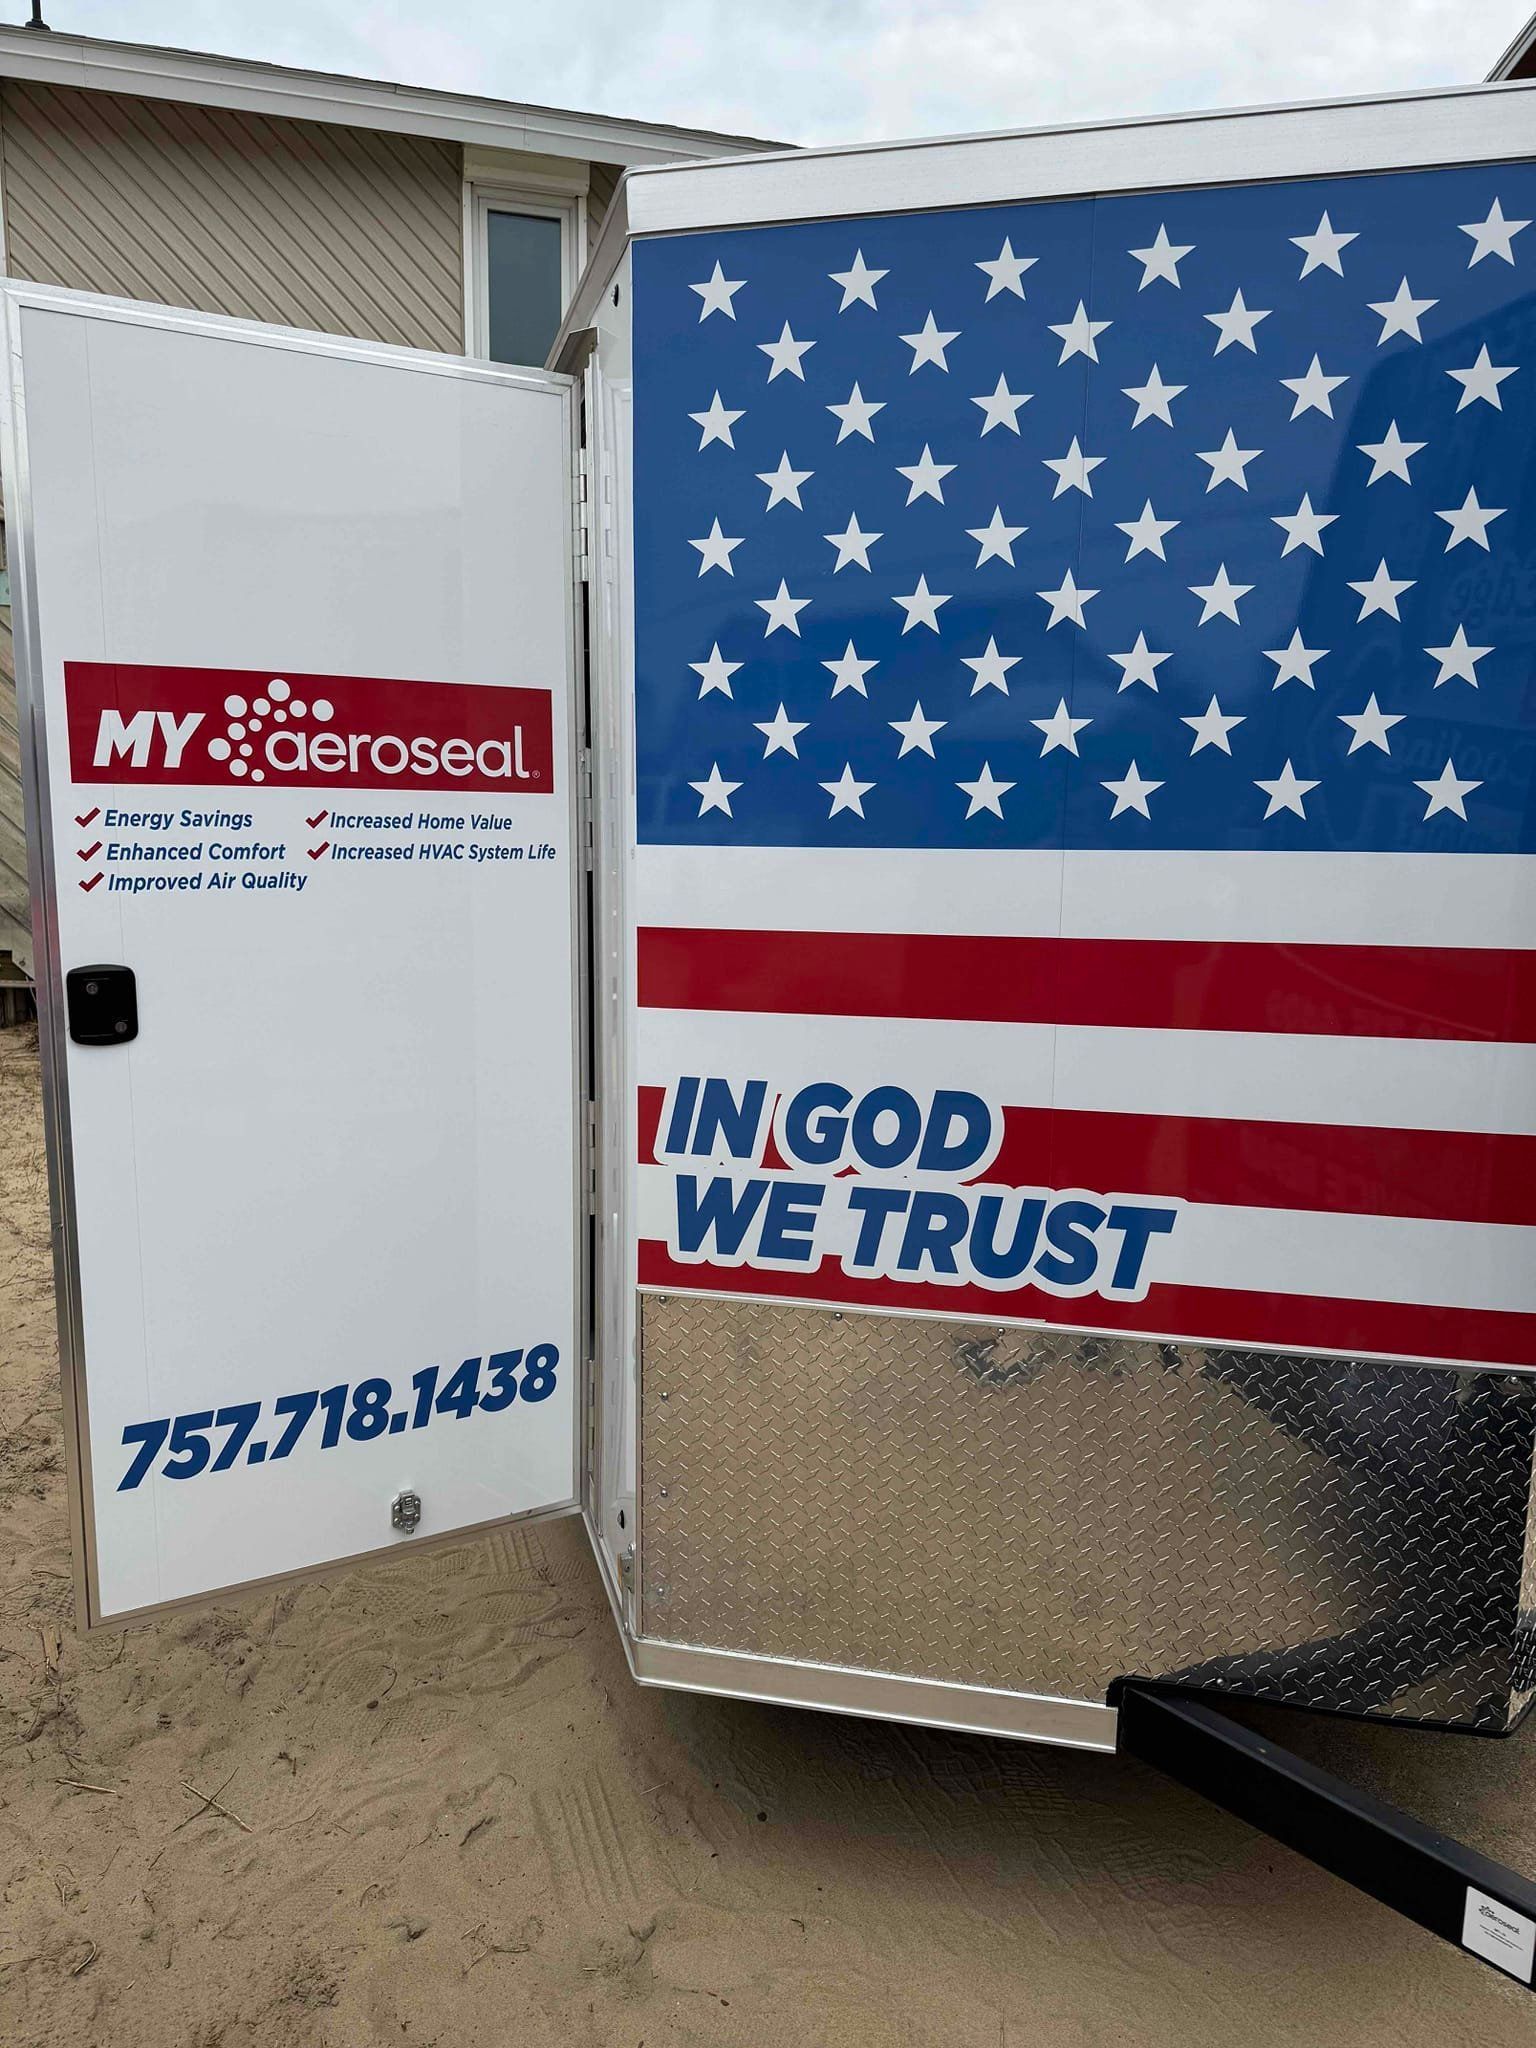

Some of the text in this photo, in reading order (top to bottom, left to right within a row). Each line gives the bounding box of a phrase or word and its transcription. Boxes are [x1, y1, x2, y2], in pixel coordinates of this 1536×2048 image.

[93, 710, 530, 779] MY aeroseal
[105, 810, 252, 830] Energy Savings
[330, 812, 512, 830] Increased Home Value
[107, 843, 286, 860] Enhanced Comfort
[332, 844, 556, 862] Increased HVAC System Life
[108, 872, 308, 894] Improved Air Quality
[667, 1078, 990, 1170] IN GOD
[677, 1176, 1175, 1288] WE TRUST
[120, 1345, 557, 1488] 757.718.1438
